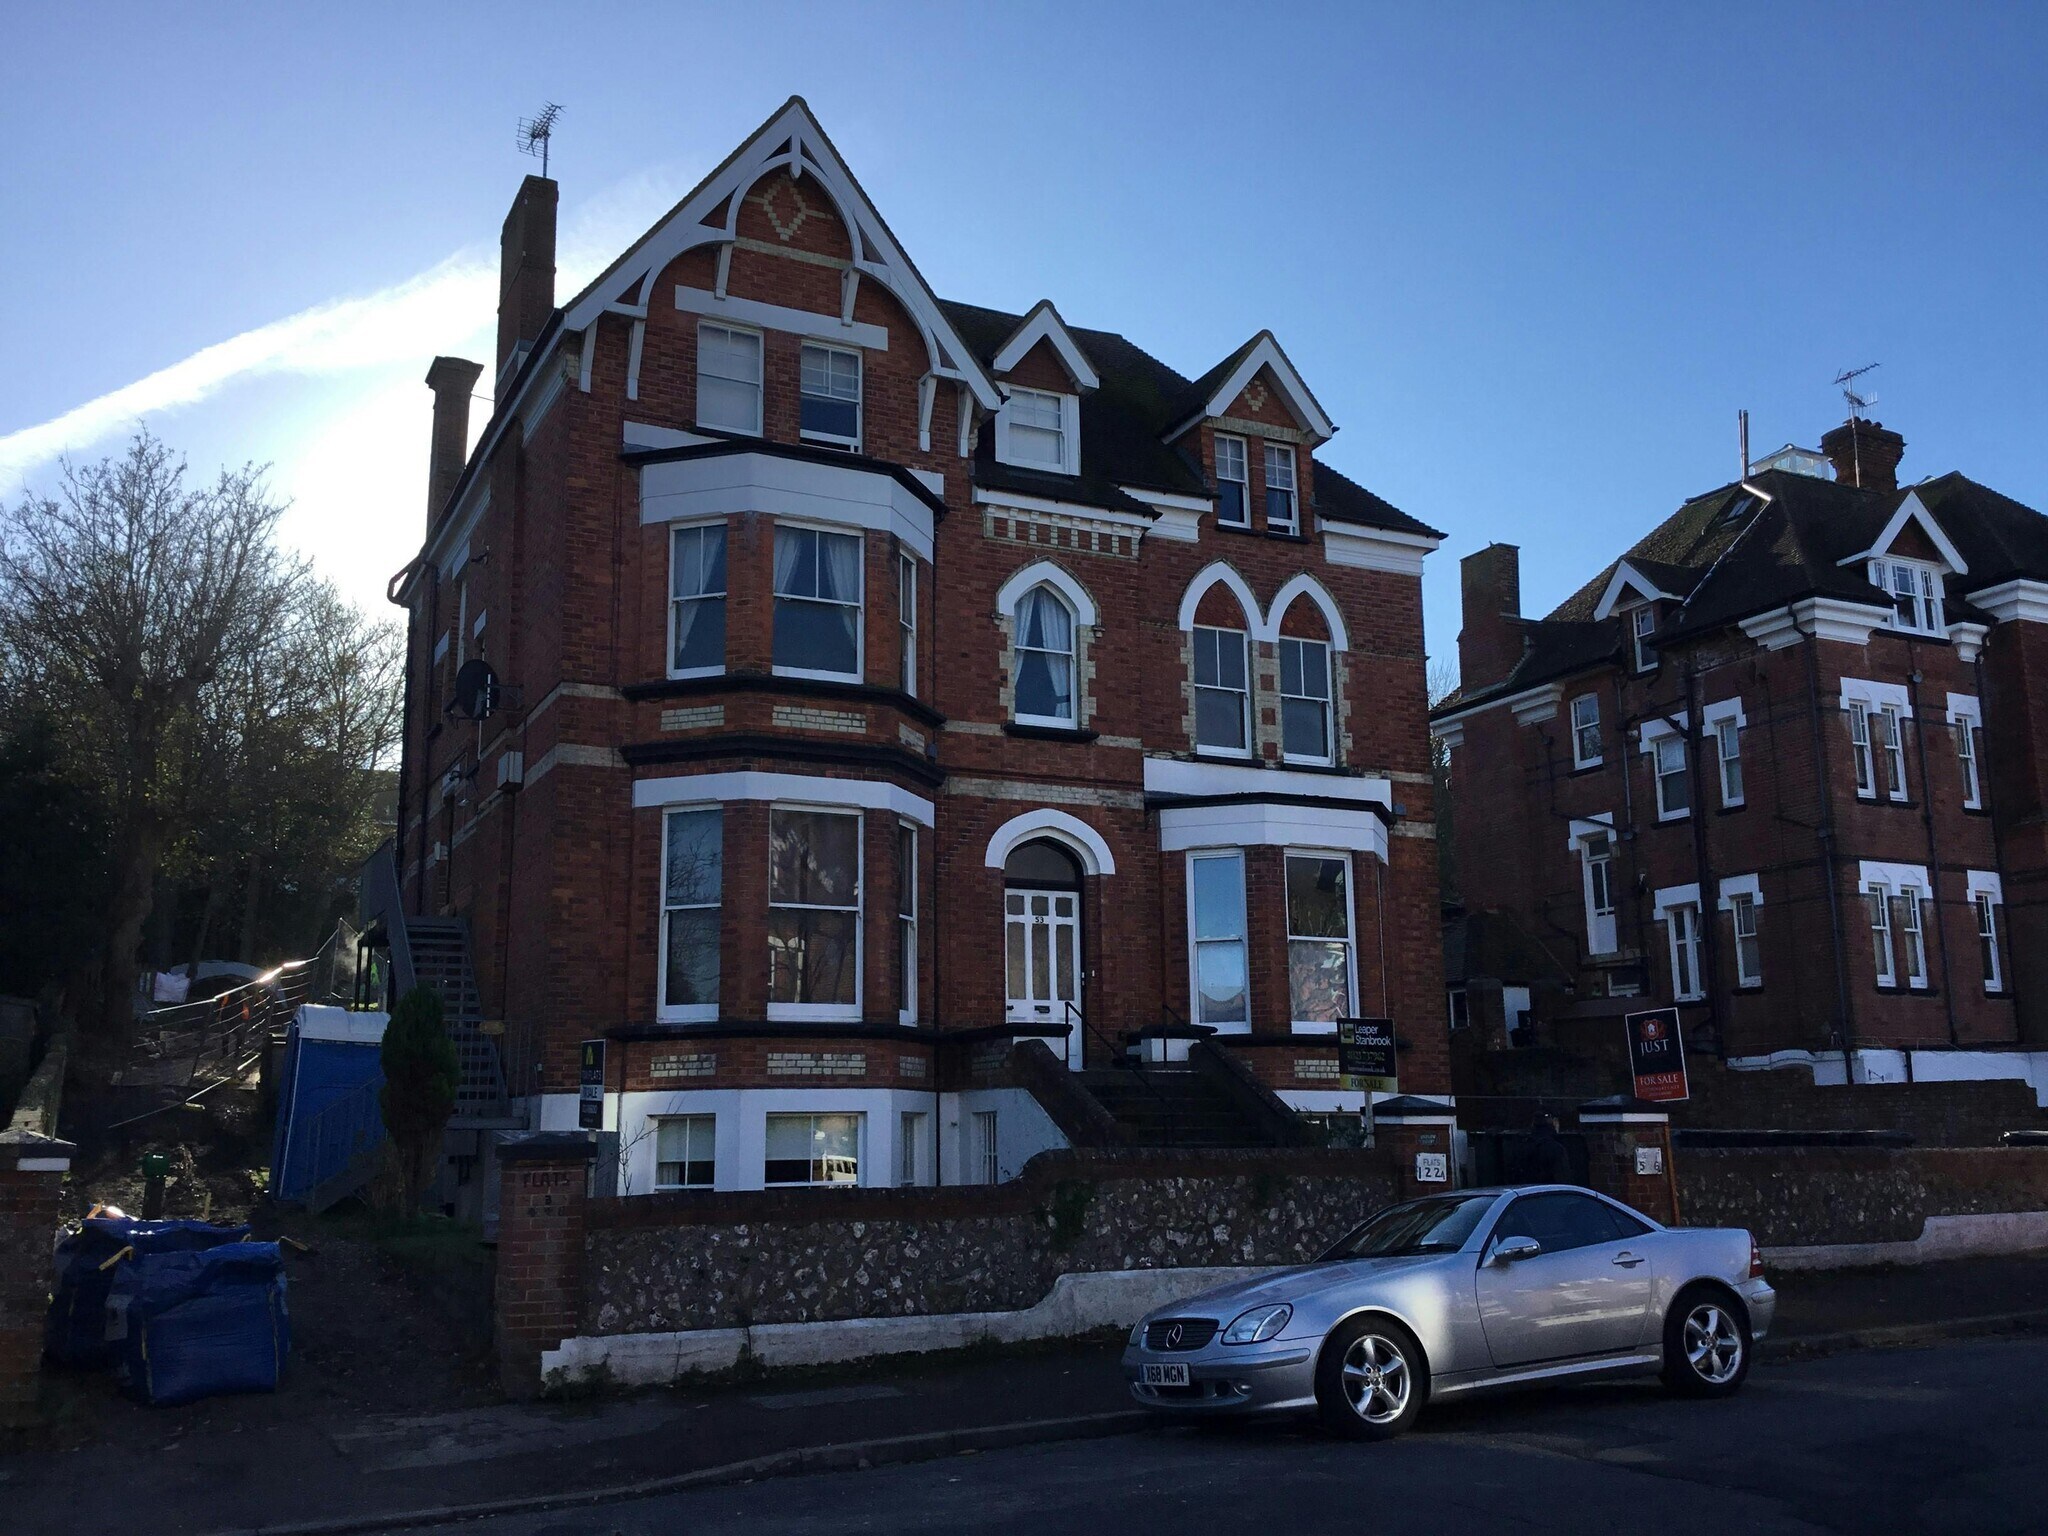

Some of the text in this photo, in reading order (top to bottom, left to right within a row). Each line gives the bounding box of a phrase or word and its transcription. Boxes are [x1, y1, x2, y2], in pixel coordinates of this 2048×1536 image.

[1035, 916, 1044, 924] 53
[1354, 1023, 1379, 1036] Leaper
[1355, 1034, 1392, 1046] Stanbrook
[1640, 1038, 1669, 1057] JUST
[1640, 1073, 1679, 1086] FOR SALE
